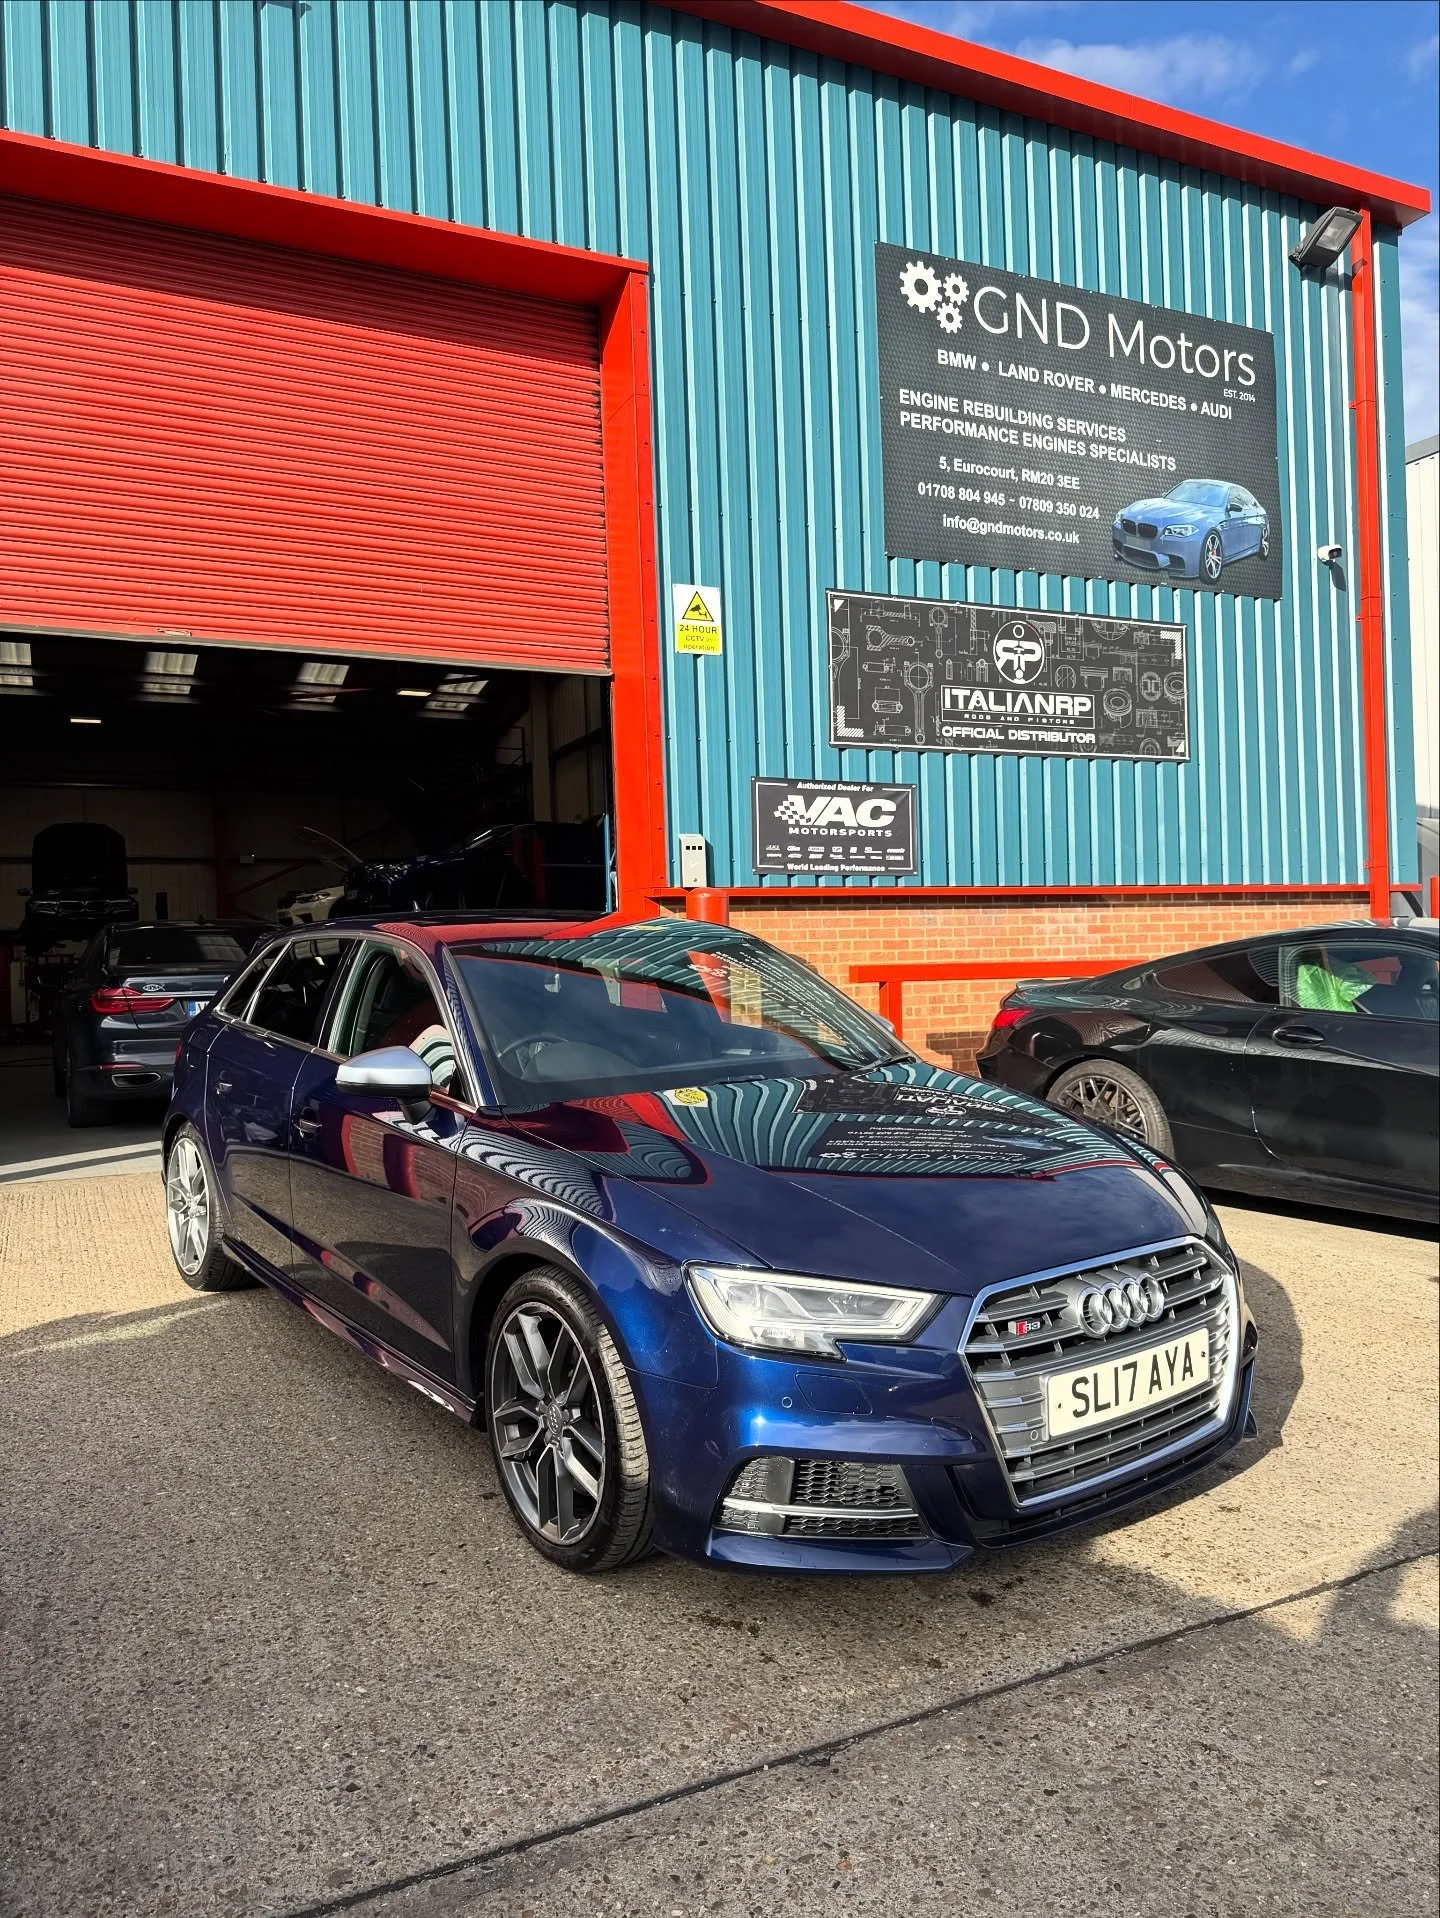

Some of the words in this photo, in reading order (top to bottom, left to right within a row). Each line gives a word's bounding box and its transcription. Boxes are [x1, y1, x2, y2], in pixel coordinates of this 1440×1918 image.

[973, 286, 1090, 350] GND
[1107, 313, 1256, 386] Motors
[937, 349, 977, 371] BMW
[999, 361, 1040, 383] LAND
[1043, 370, 1095, 394] ROVER
[1110, 382, 1187, 411] MERCEDES
[1200, 401, 1232, 420] AUDI
[1223, 388, 1238, 399] EST.
[1239, 391, 1256, 403] 2014
[899, 388, 959, 413] ENGINE
[963, 399, 1054, 430] REBUILDING
[1056, 416, 1127, 442] SERVICES
[900, 410, 1019, 445] PERFORMANCE
[1022, 431, 1087, 456] ENGINES
[1089, 443, 1177, 471] SPECIALISTS
[938, 456, 951, 472] 5,
[953, 458, 1019, 483] Eurocourt,
[1021, 468, 1054, 486] RM20
[1057, 475, 1081, 490] 3EE
[917, 482, 956, 499] 01708
[958, 487, 981, 503] 804
[983, 491, 1006, 506] 945
[1019, 496, 1053, 513] 07809
[1056, 501, 1077, 516] 350
[1079, 505, 1101, 520] 024
[942, 513, 1080, 544] info@gndmotors.co.uk
[679, 624, 689, 632] 24
[692, 625, 718, 635] HOUR
[944, 688, 1092, 716] ITALIANRP
[941, 725, 1005, 740] OFFICIAL
[1008, 729, 1096, 744] DISTRIBUTOR
[964, 713, 991, 721] RODS
[1027, 717, 1075, 725] PISTONS
[797, 782, 836, 791] Authorized
[837, 784, 861, 792] Dealer
[785, 795, 897, 828] VAC
[788, 827, 893, 837] MOTORSPORTS
[787, 863, 809, 871] World
[810, 864, 839, 872] Leading
[1071, 1361, 1138, 1419] SL17
[1148, 1341, 1194, 1395] AYA
